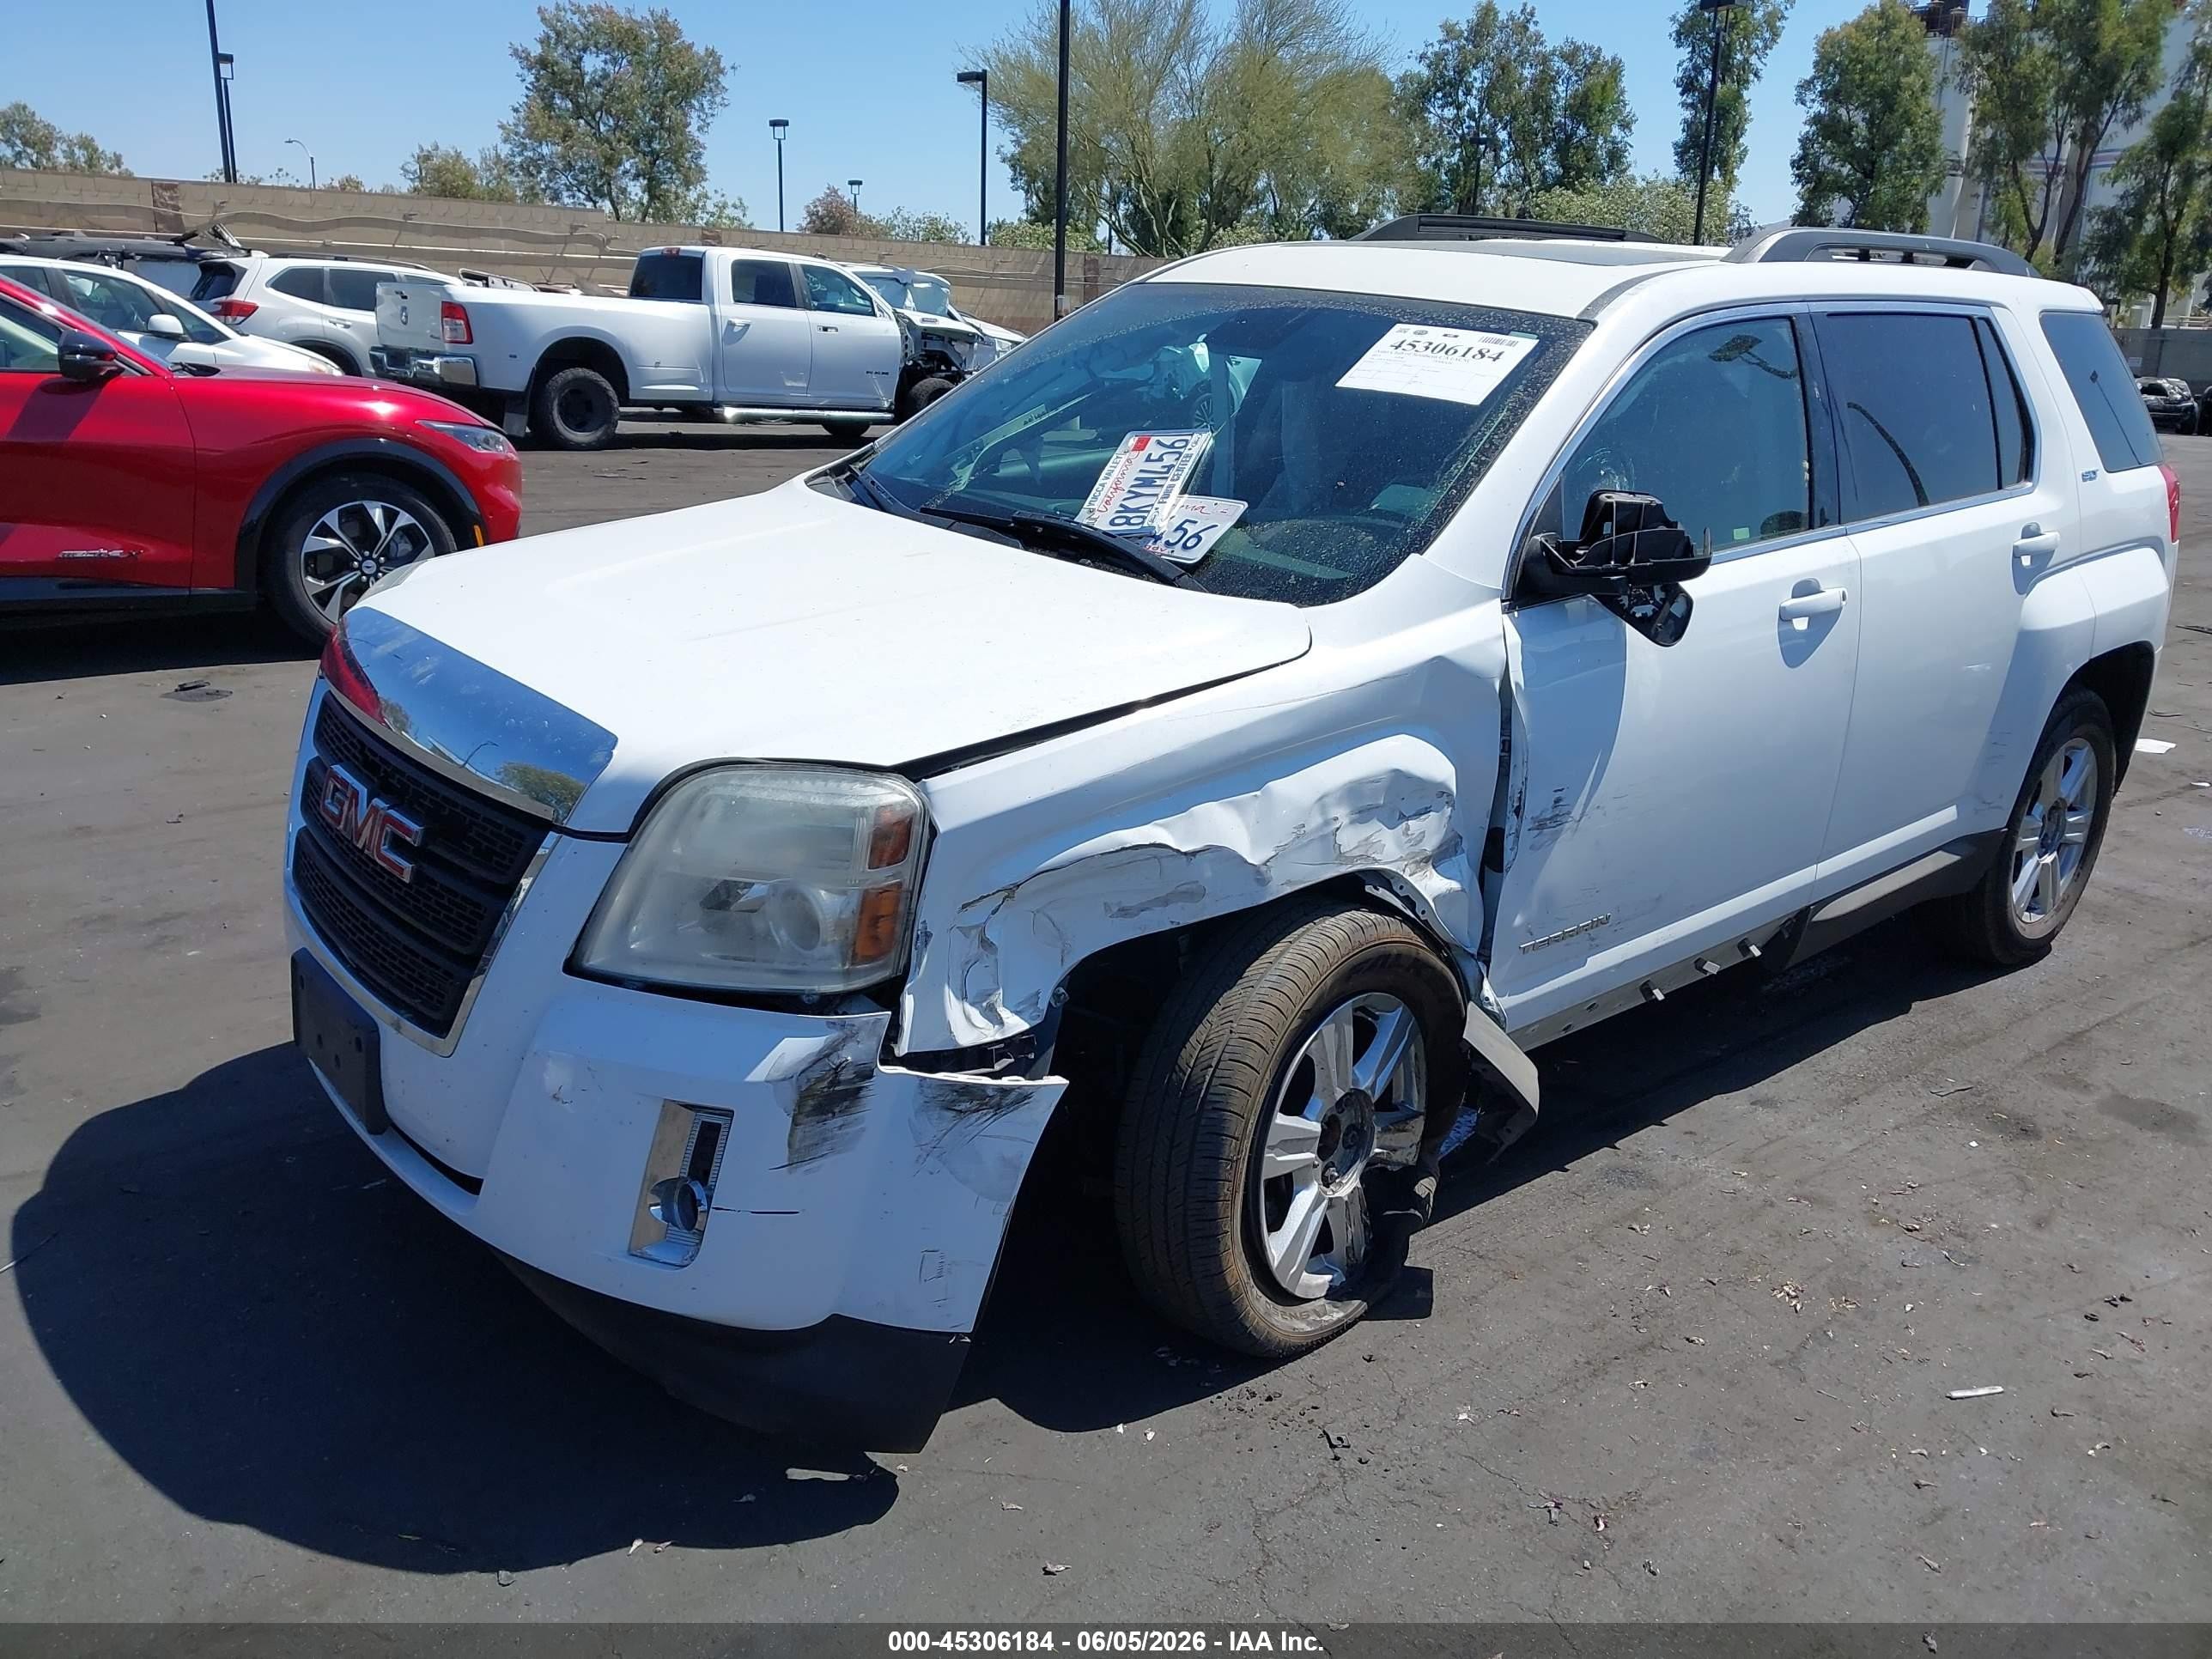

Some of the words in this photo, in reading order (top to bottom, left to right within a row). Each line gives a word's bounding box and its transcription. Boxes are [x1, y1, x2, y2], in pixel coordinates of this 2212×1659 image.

[1389, 338, 1505, 362] 45306184
[1102, 455, 1123, 481] VALLEY
[1109, 438, 1189, 527] 8KYM456
[320, 764, 424, 884] GMC
[1518, 913, 1612, 955] TERRAIN
